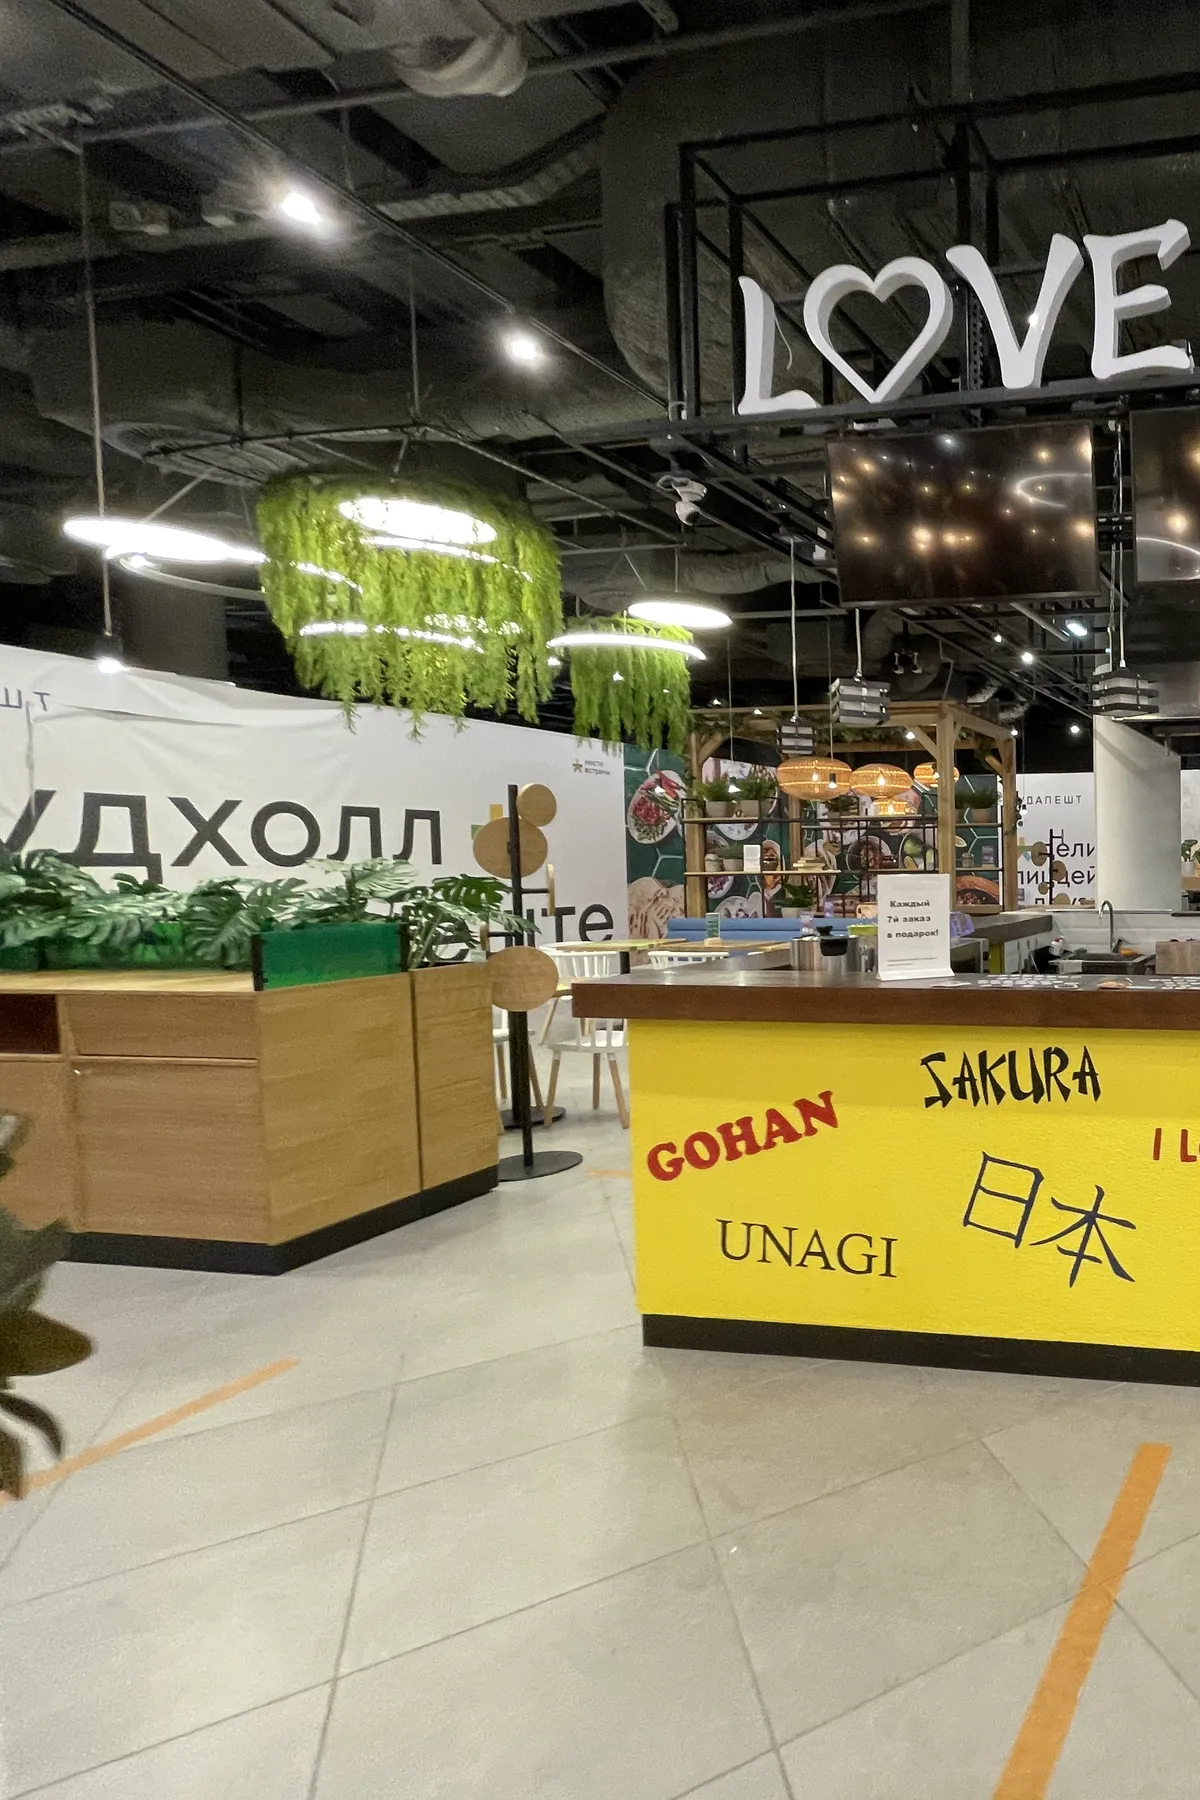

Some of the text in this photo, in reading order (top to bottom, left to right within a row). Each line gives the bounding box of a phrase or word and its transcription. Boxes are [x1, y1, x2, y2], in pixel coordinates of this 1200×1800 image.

[889, 900, 931, 908] Каждый
[902, 915, 931, 923] заказ
[895, 929, 939, 939] подарок!
[920, 1045, 1102, 1109] SAKURA
[647, 1090, 839, 1182] GOHAN
[1153, 1127, 1162, 1161] I
[962, 1151, 1137, 1288] 日本
[716, 1218, 899, 1279] UNAGI
